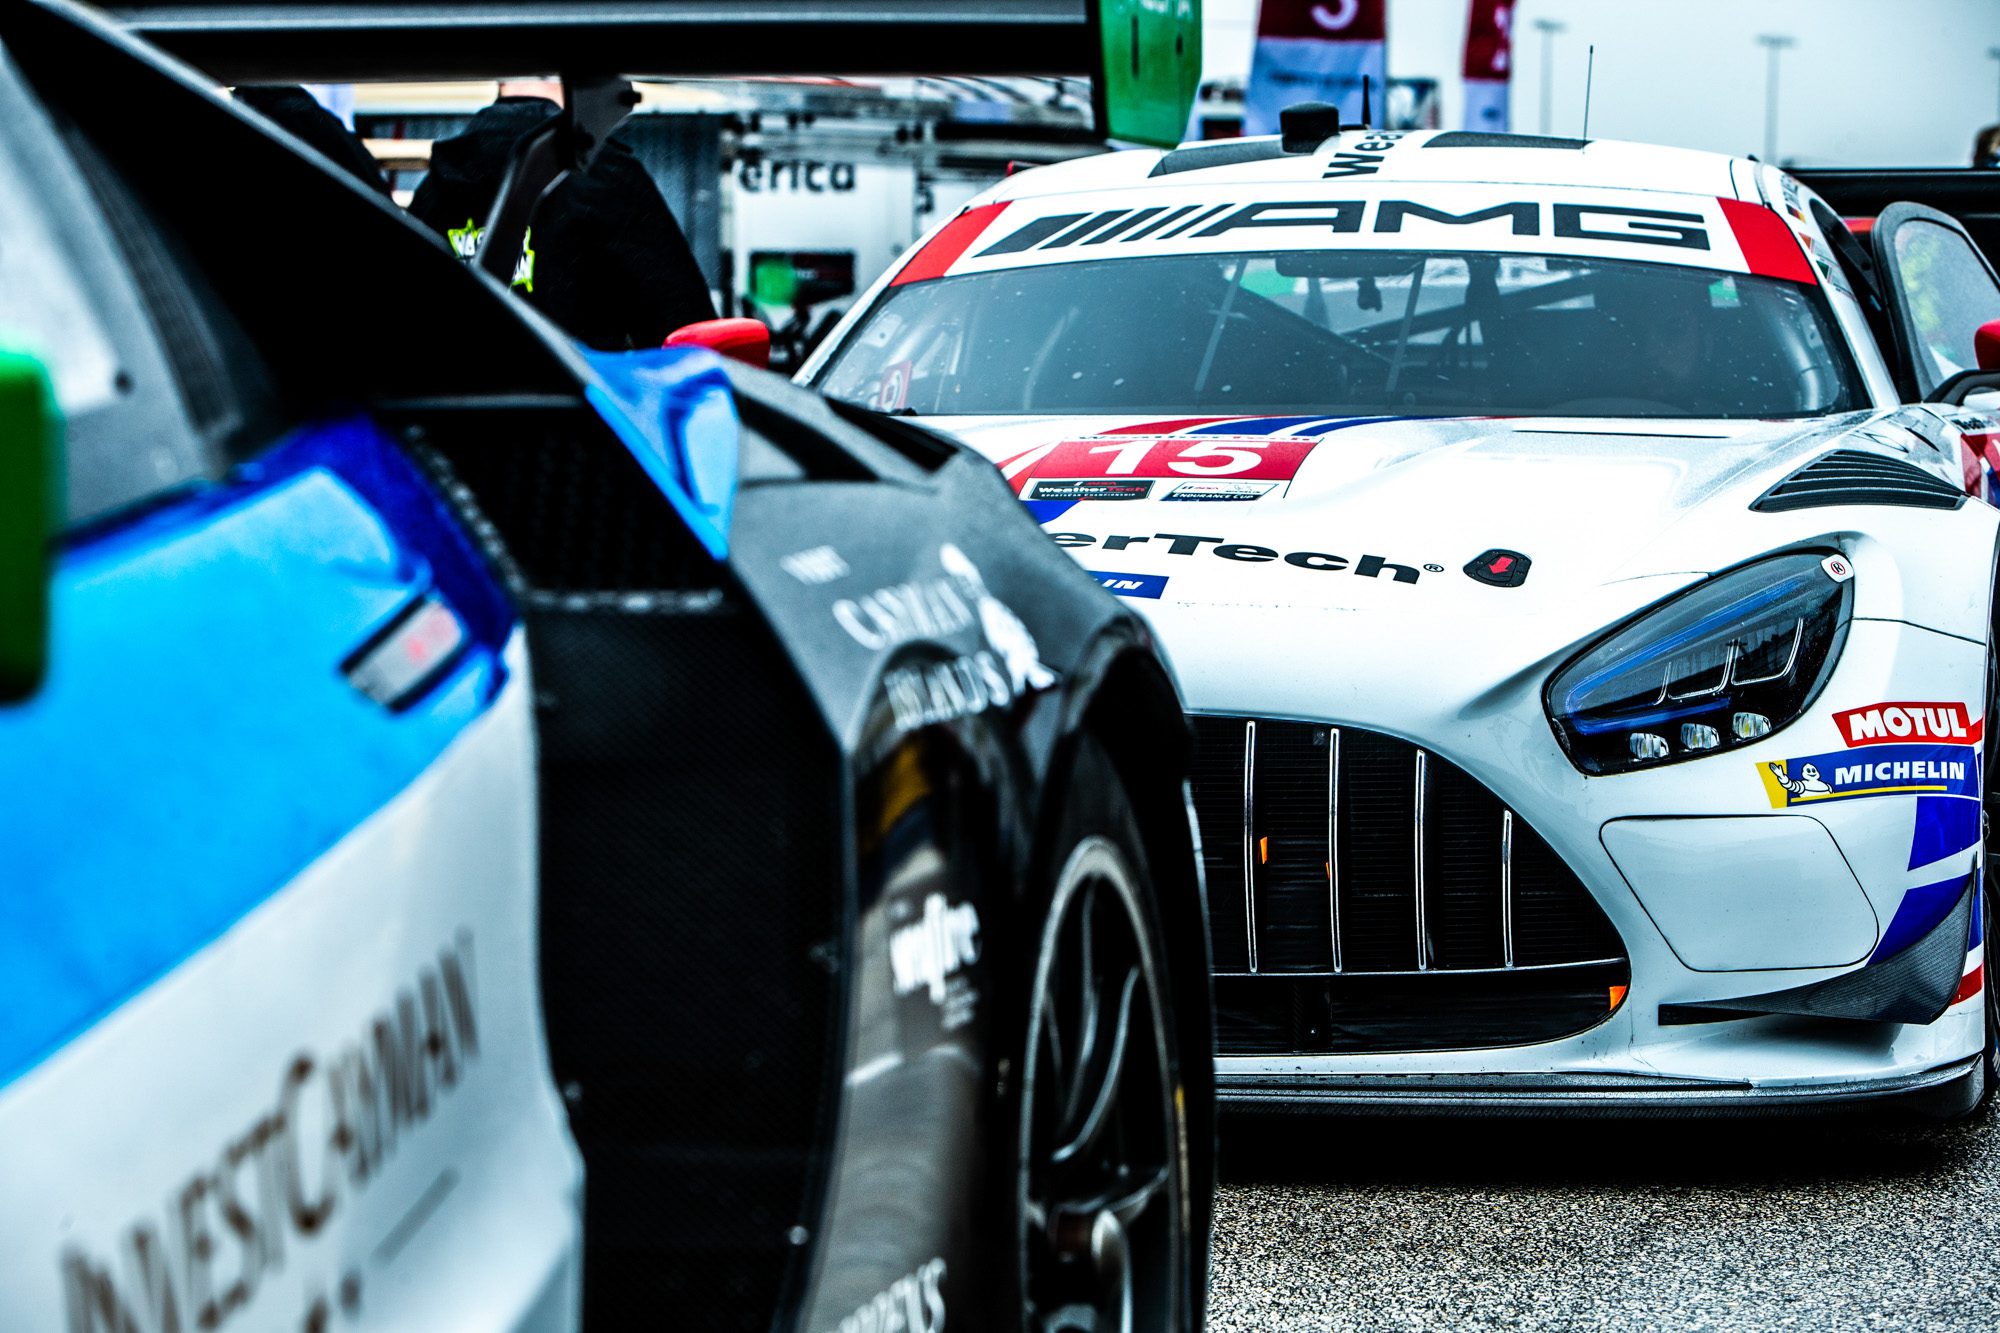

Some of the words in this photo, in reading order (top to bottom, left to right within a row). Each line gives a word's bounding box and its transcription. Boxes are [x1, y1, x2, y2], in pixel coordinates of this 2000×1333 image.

[1189, 200, 1710, 251] AMG
[1088, 440, 1271, 476] 15
[1848, 706, 1968, 742] MOTUL
[1834, 760, 1965, 786] MICHELIN
